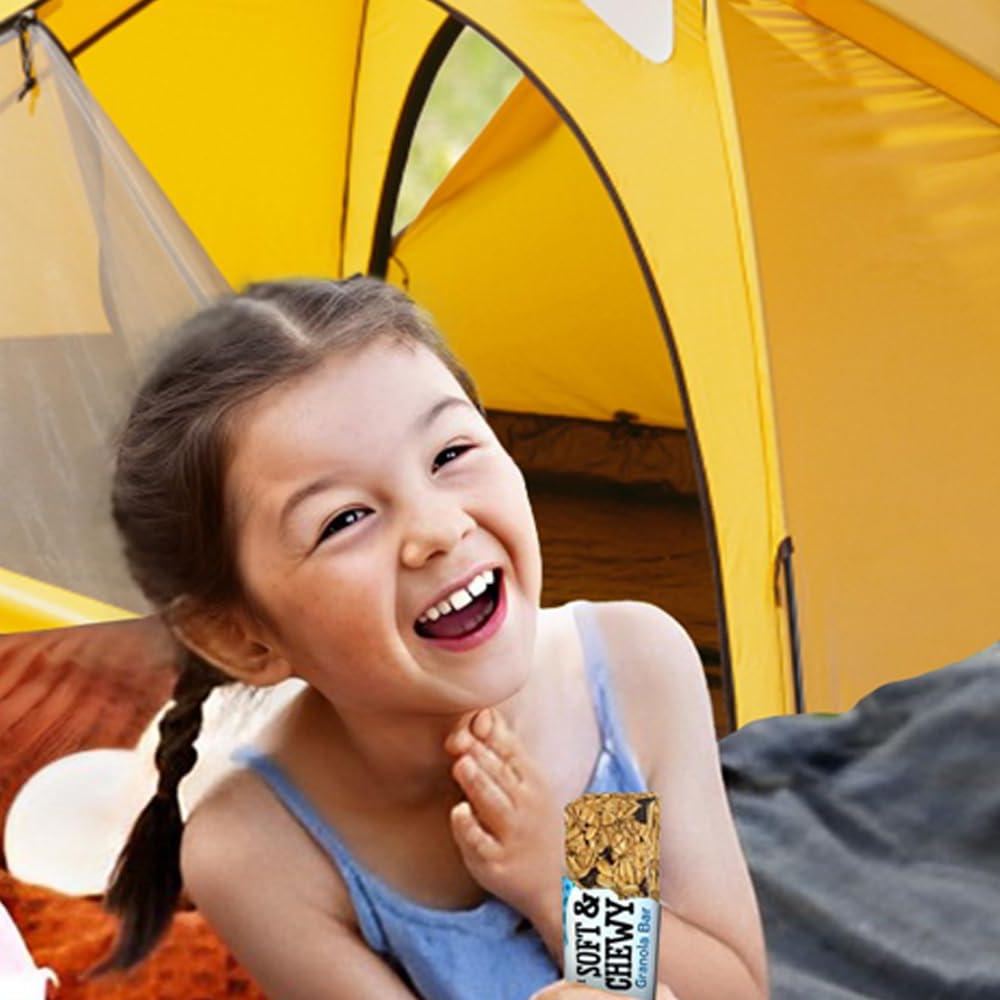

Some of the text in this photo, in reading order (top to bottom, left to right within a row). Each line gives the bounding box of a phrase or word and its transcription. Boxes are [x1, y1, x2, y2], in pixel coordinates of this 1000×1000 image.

[574, 892, 602, 978] SOFT &
[605, 897, 634, 990] CHEWY
[635, 907, 651, 989] Granola Bar
